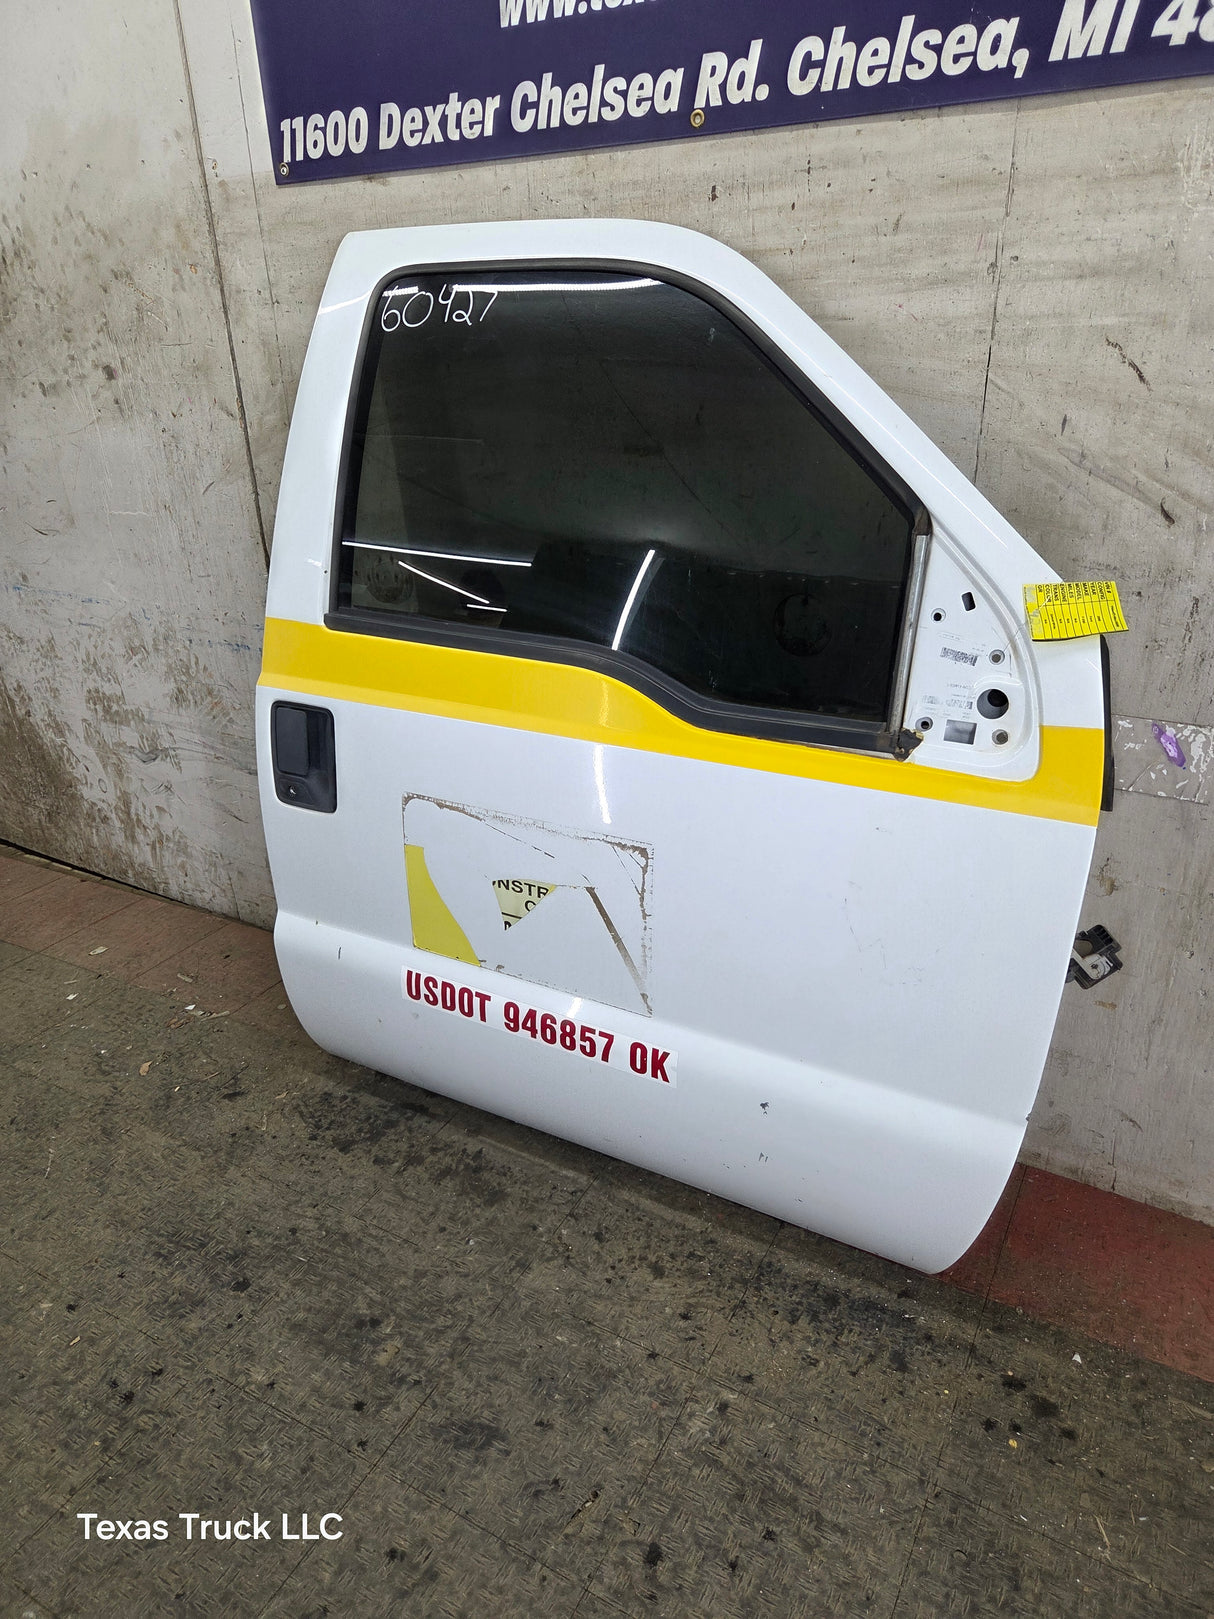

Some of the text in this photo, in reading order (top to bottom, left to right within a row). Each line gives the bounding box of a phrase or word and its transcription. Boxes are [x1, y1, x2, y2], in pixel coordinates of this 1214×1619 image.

[280, 106, 369, 163] 11600
[378, 92, 501, 151] Dexter
[510, 64, 685, 133] Chelsea
[693, 39, 770, 109] Rd.
[786, 15, 1030, 94] Chelsea,
[1048, 0, 1142, 62] MI
[381, 284, 498, 332] 60427
[1059, 583, 1068, 602] ENGINE
[1074, 583, 1082, 600] MODEL
[1082, 582, 1090, 596] MAKE
[1097, 581, 1106, 600] CONFIG
[492, 879, 549, 898] NSTR
[405, 969, 671, 1084] USDOT 946857 OK
